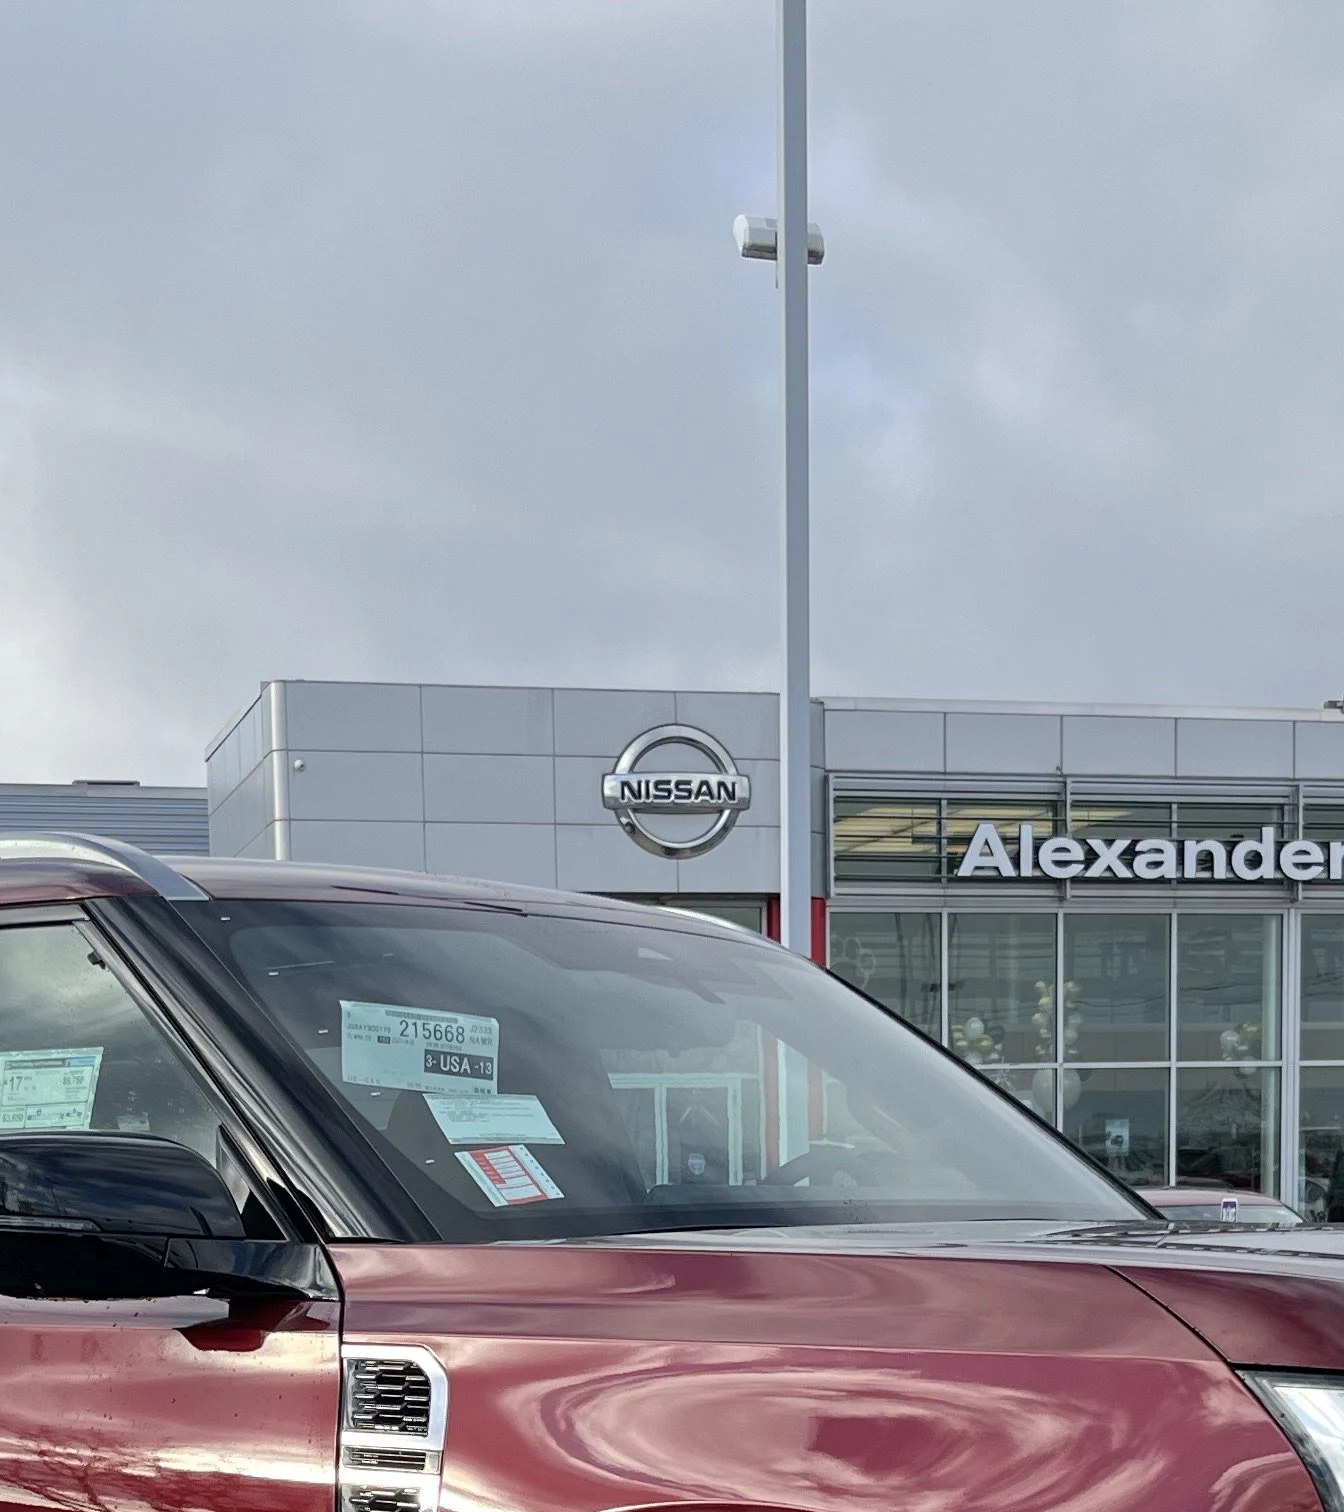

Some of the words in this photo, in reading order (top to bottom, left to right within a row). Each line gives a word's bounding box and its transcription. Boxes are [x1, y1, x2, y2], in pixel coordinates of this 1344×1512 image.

[620, 780, 738, 803] NISSAN
[399, 1018, 465, 1044] 215668
[440, 1054, 471, 1075] USA
